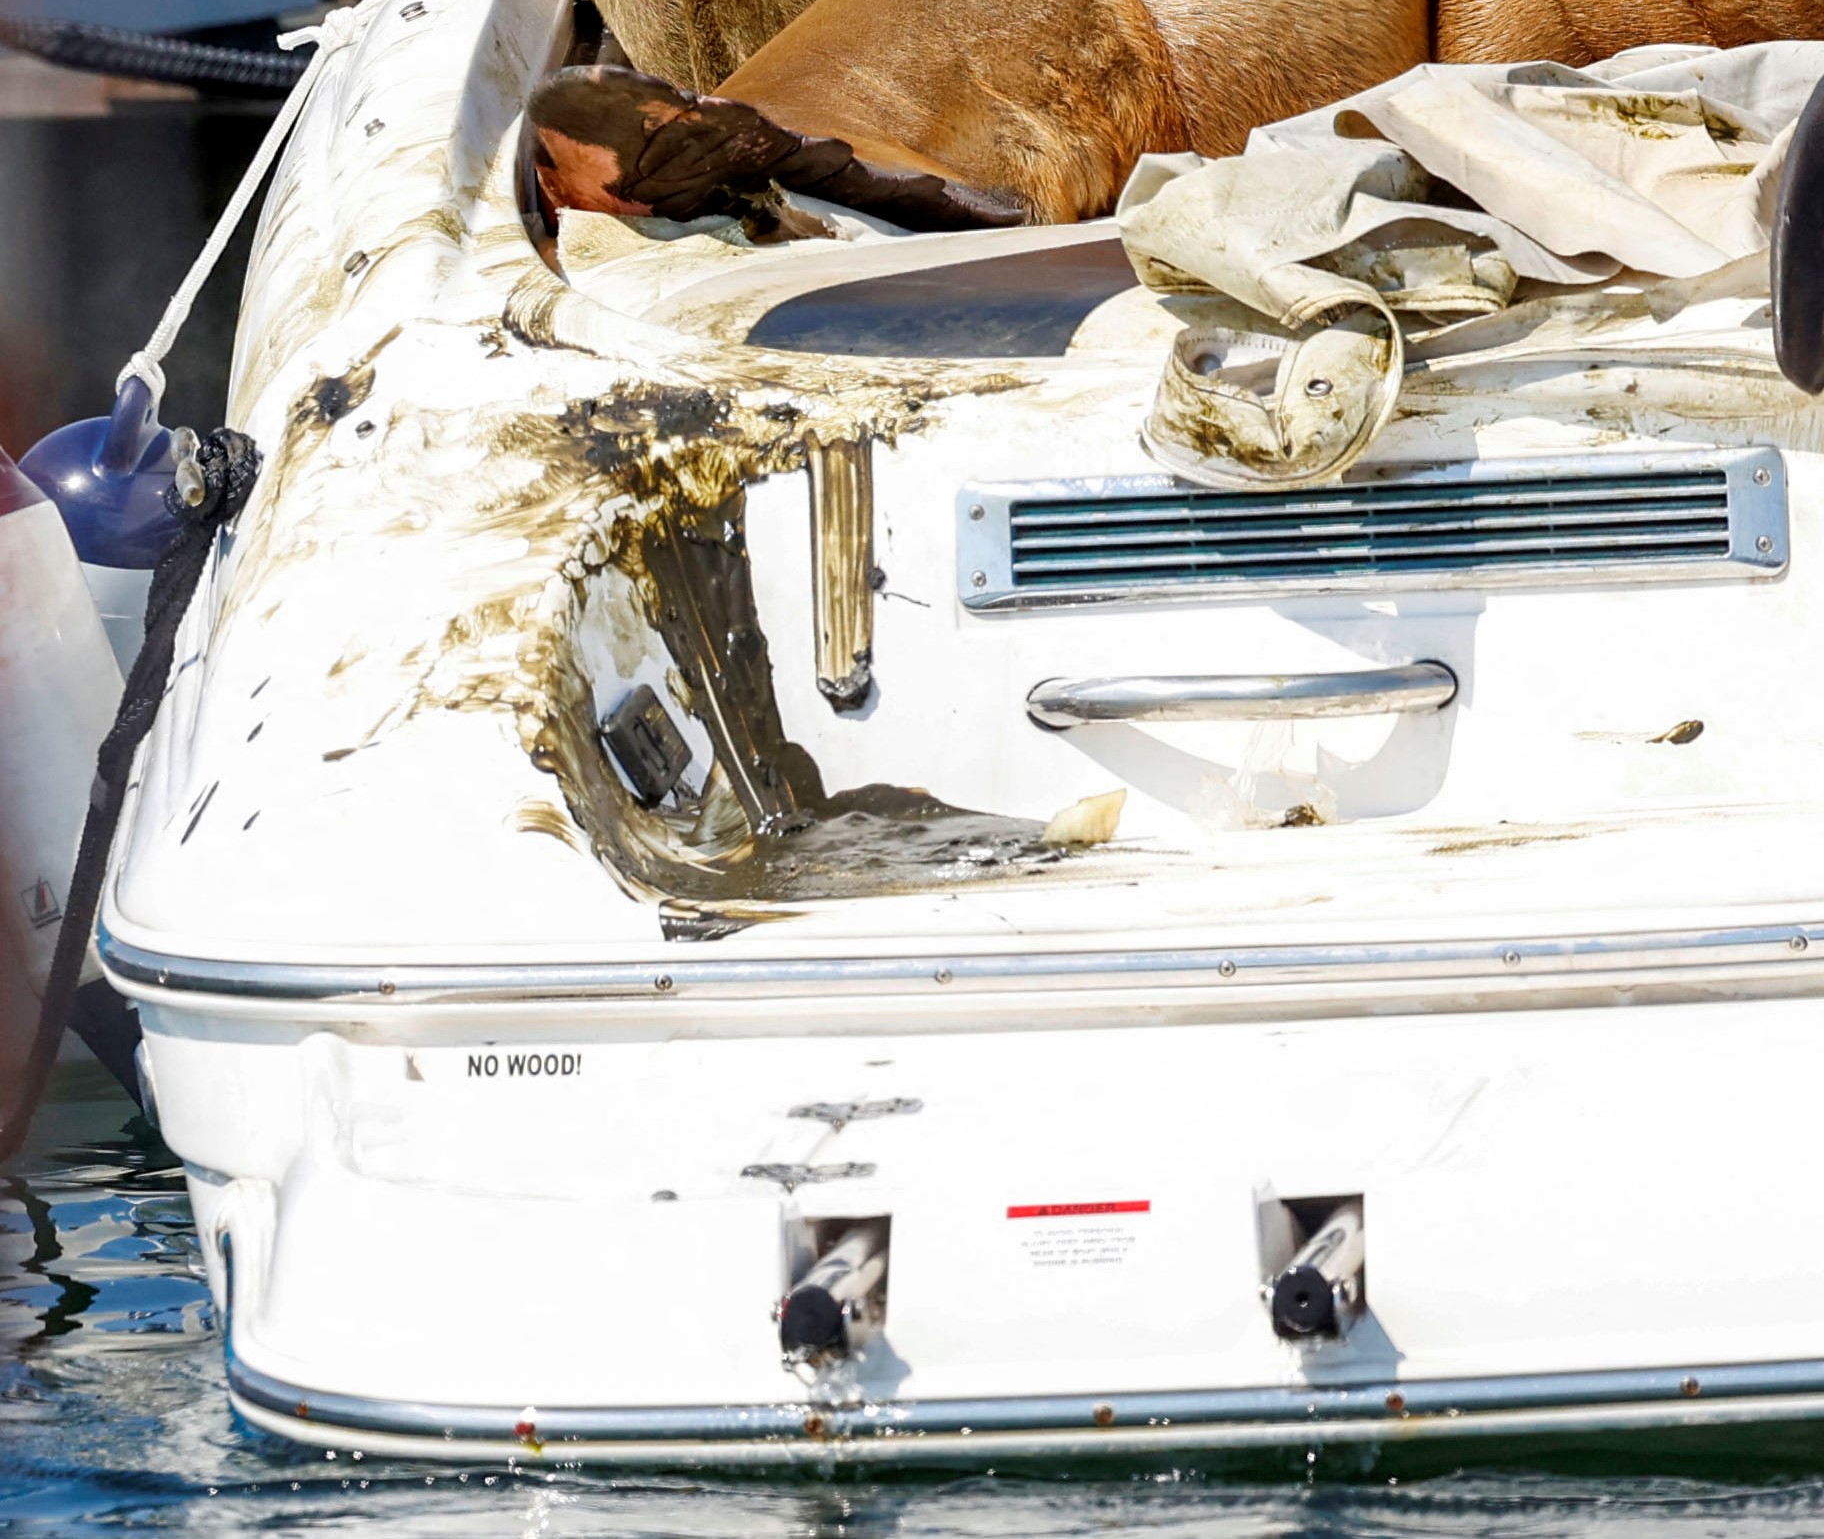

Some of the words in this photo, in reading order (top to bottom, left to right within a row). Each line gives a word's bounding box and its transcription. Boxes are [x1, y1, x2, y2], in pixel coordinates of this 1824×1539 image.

[468, 1055, 499, 1077] NO
[507, 1054, 582, 1076] WOOD!
[1050, 1202, 1115, 1216] DANGER
